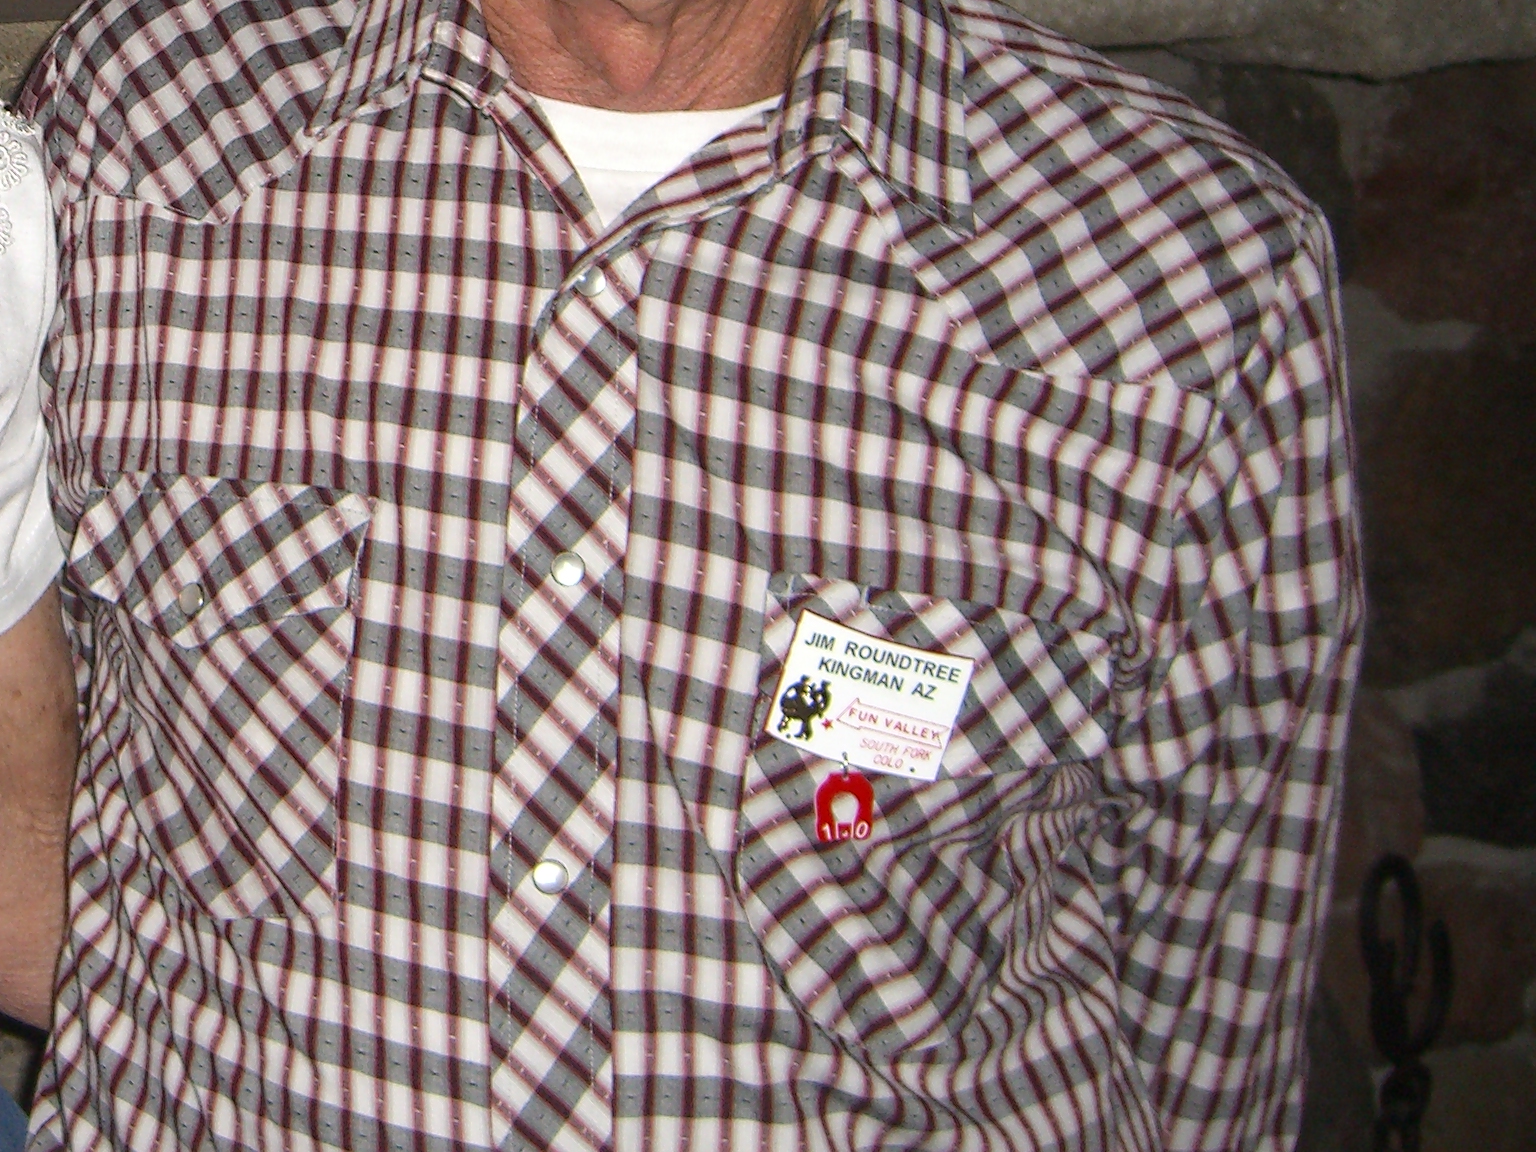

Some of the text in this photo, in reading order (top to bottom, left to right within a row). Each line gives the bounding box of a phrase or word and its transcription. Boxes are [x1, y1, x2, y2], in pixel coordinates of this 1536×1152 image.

[804, 632, 961, 684] JIM ROUNDTREE
[818, 657, 938, 701] KINGMAN AZ
[848, 707, 940, 741] FUN VALLEY
[860, 738, 932, 761] SOUTH FORK
[873, 754, 904, 768] COLO
